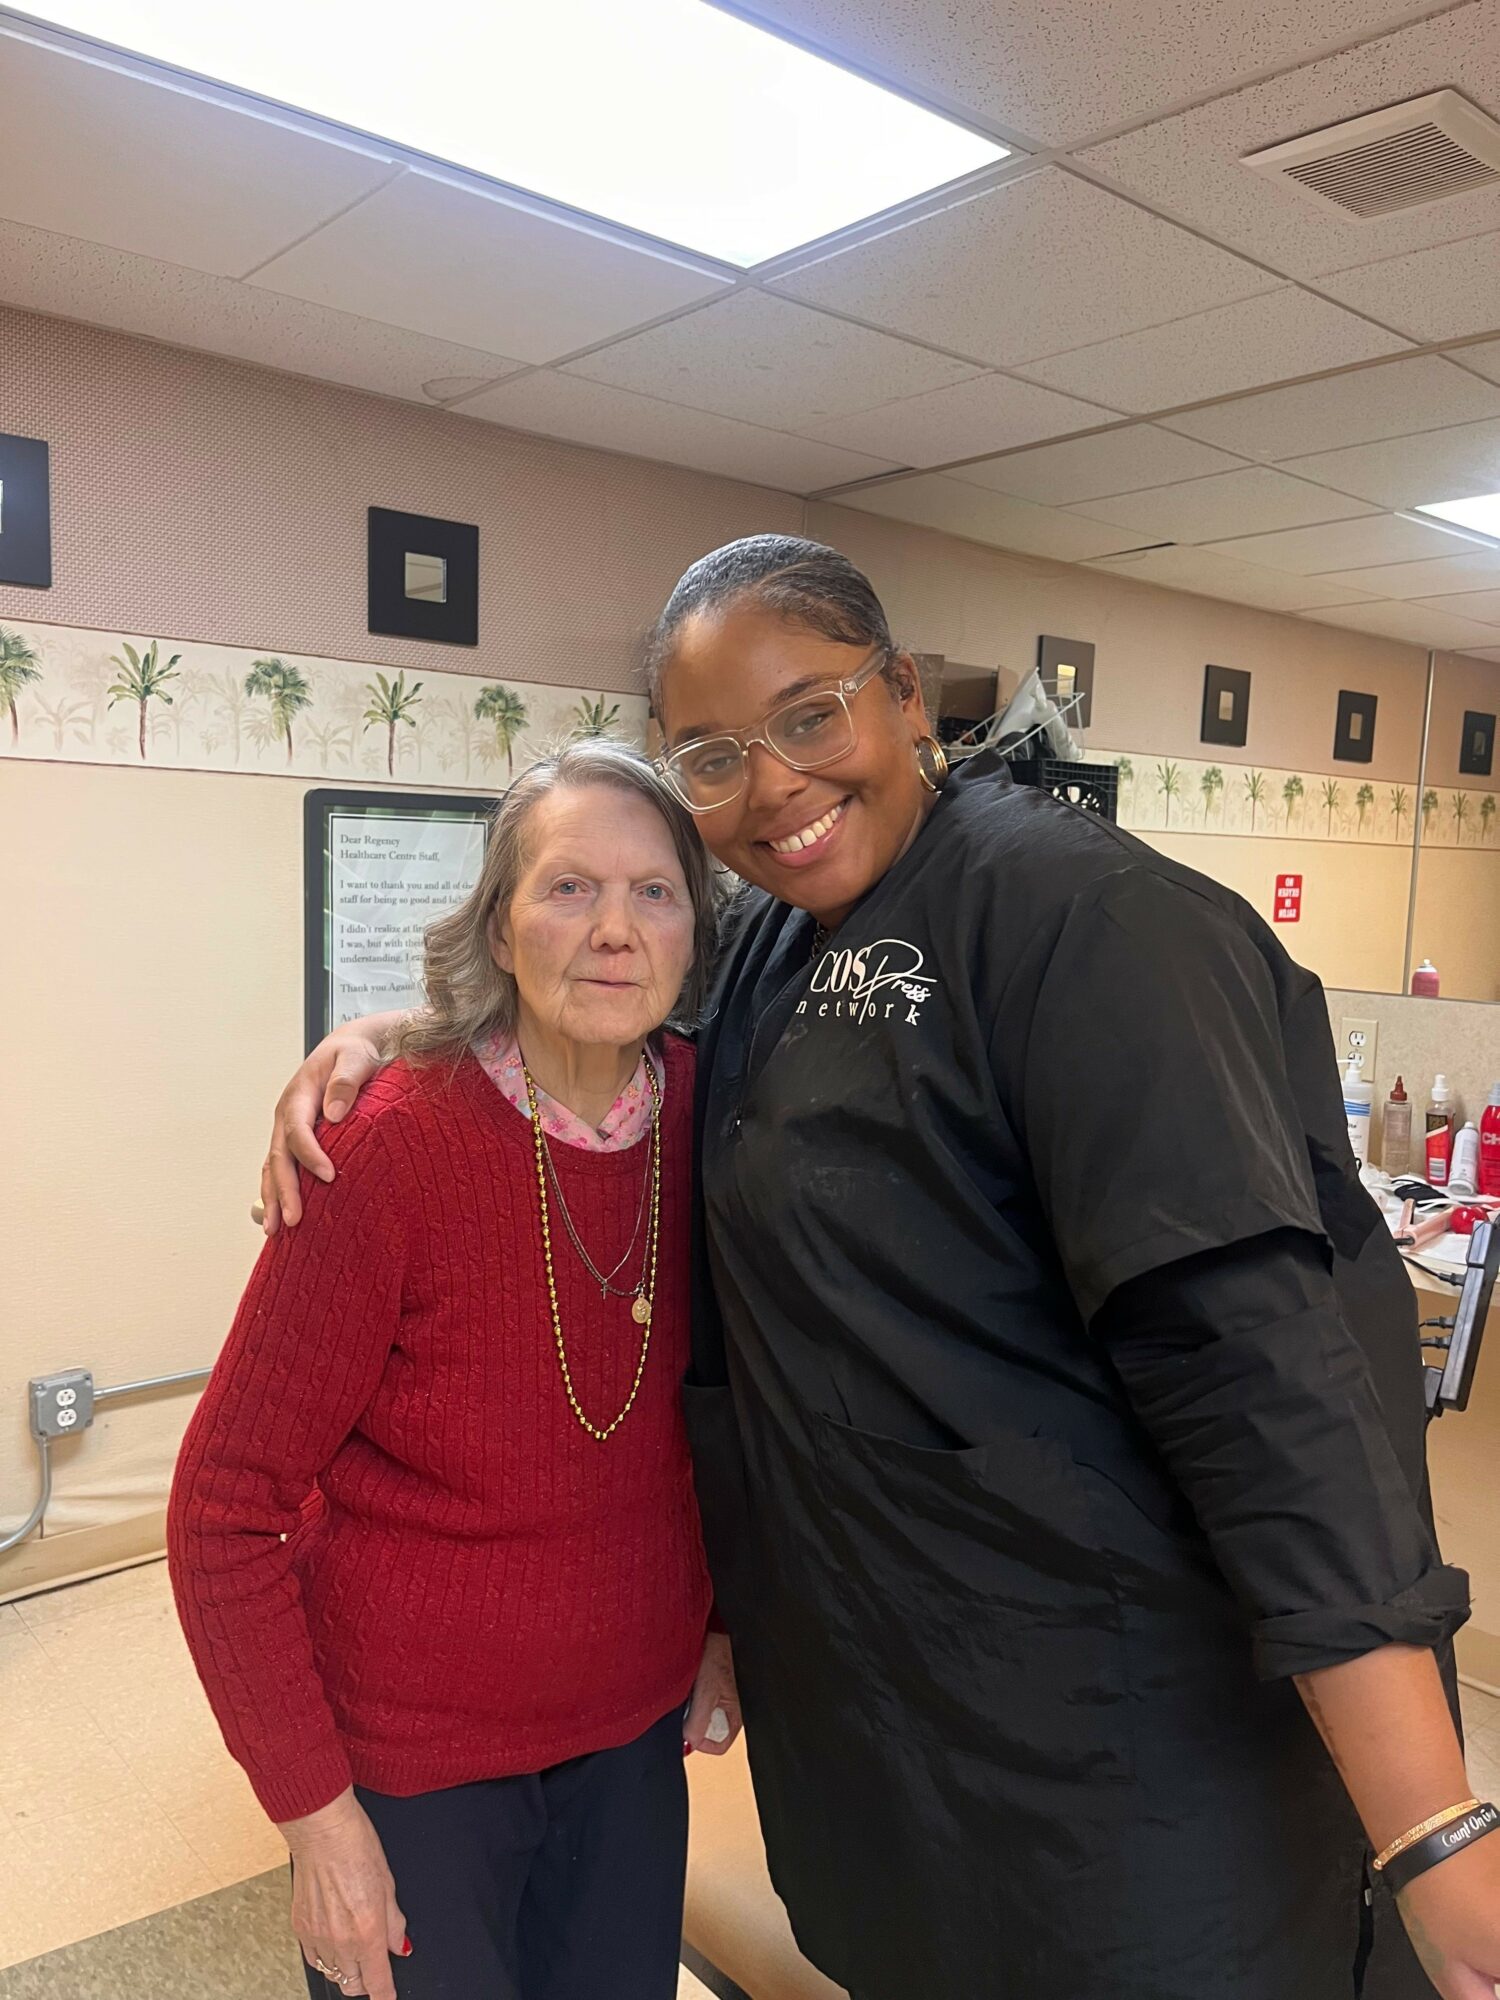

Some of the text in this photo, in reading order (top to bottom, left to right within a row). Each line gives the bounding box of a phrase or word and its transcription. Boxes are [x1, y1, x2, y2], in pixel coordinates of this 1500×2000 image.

[340, 834, 400, 847] Dear Regency
[340, 849, 386, 860] Healthcare
[389, 850, 416, 860] Centre
[346, 881, 368, 889] want
[370, 881, 379, 889] to
[381, 880, 405, 889] thank
[407, 882, 422, 892] you
[424, 881, 439, 890] and
[441, 881, 450, 890] all
[453, 881, 461, 890] of
[340, 894, 359, 904] staff
[360, 894, 372, 903] for
[374, 895, 397, 906] being
[410, 895, 430, 906] good
[432, 896, 447, 904] and
[374, 924, 400, 933] realize
[402, 925, 410, 933] at
[346, 941, 365, 949] was,
[367, 939, 382, 948] but
[384, 939, 402, 948] with
[340, 955, 403, 965] understanding,
[340, 983, 369, 993] Thank
[370, 985, 387, 994] you
[795, 1000, 921, 1026] network
[1441, 1821, 1471, 1848] Count
[1468, 1815, 1487, 1831] On
